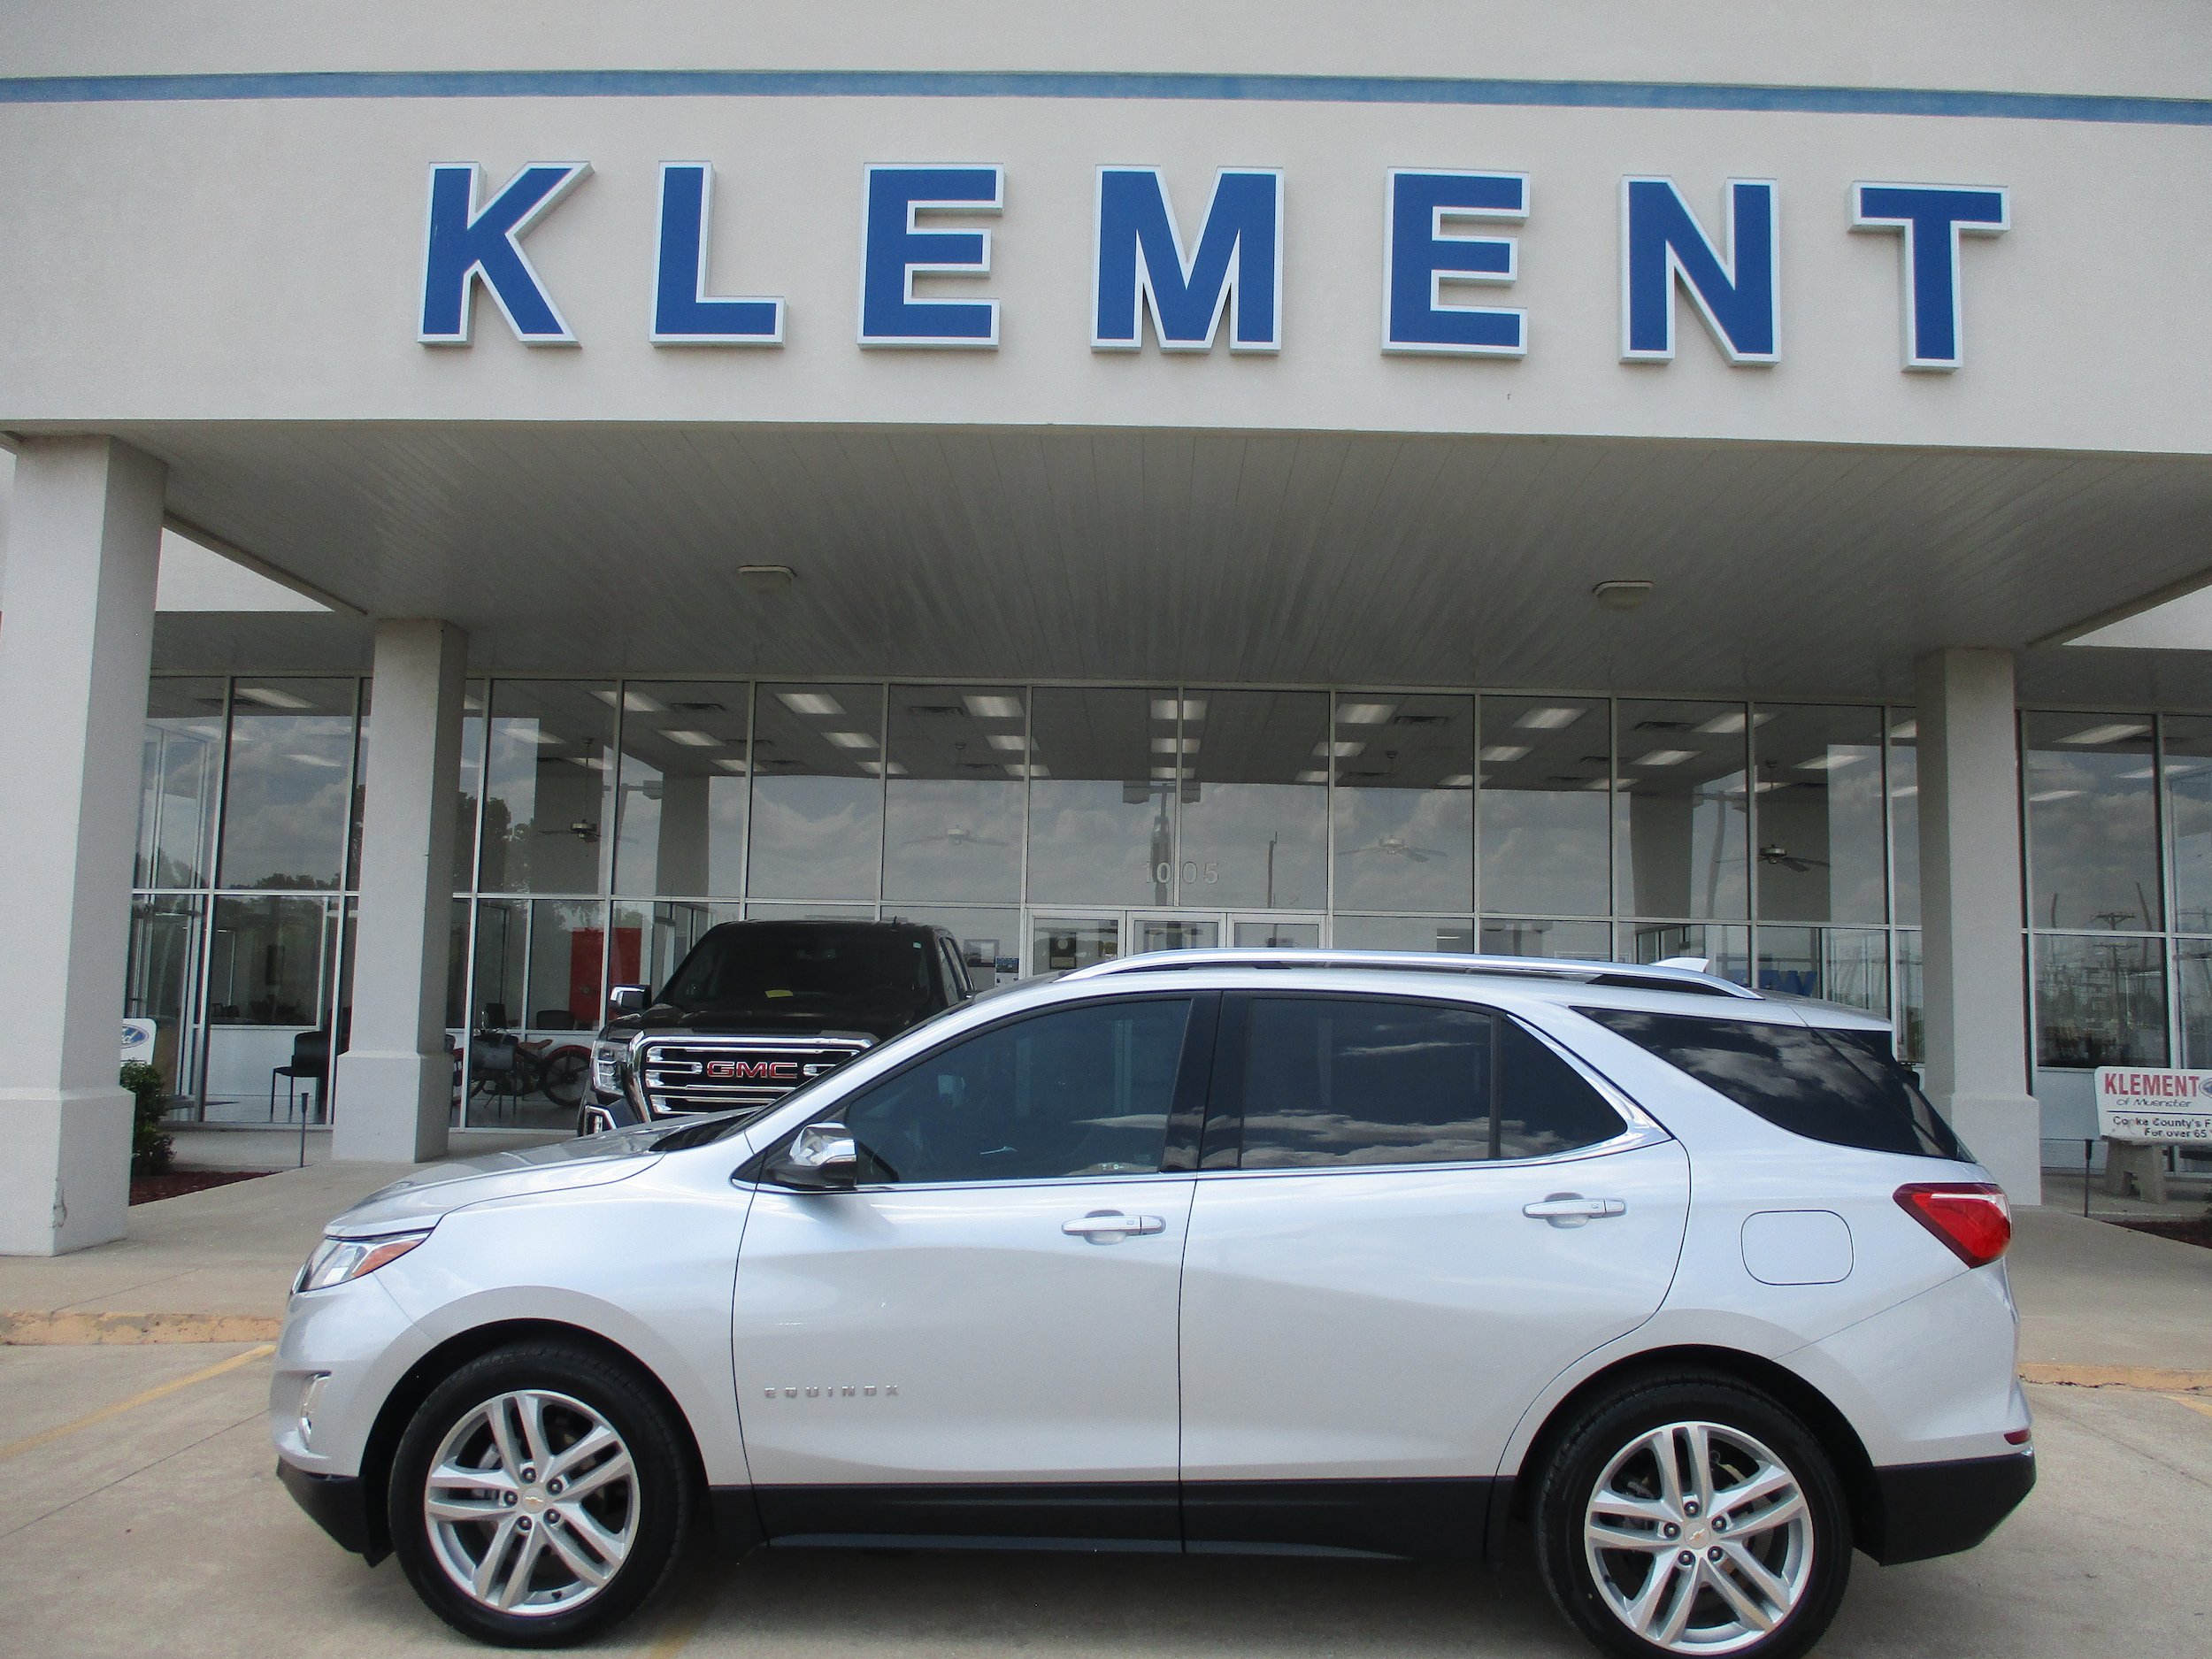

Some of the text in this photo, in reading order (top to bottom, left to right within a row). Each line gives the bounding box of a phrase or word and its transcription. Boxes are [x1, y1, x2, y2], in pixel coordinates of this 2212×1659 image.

[417, 161, 2010, 373] KLEMENT
[1141, 861, 1218, 884] 1005
[707, 1061, 797, 1079] GMC
[2104, 1072, 2200, 1096] KLEMENT
[2116, 1097, 2192, 1107] of Muenster
[2112, 1116, 2148, 1125] Coke
[2152, 1118, 2200, 1129] County's
[2144, 1127, 2162, 1136] For
[2194, 1129, 2207, 1138] 65
[764, 1385, 898, 1398] EQUINOX
